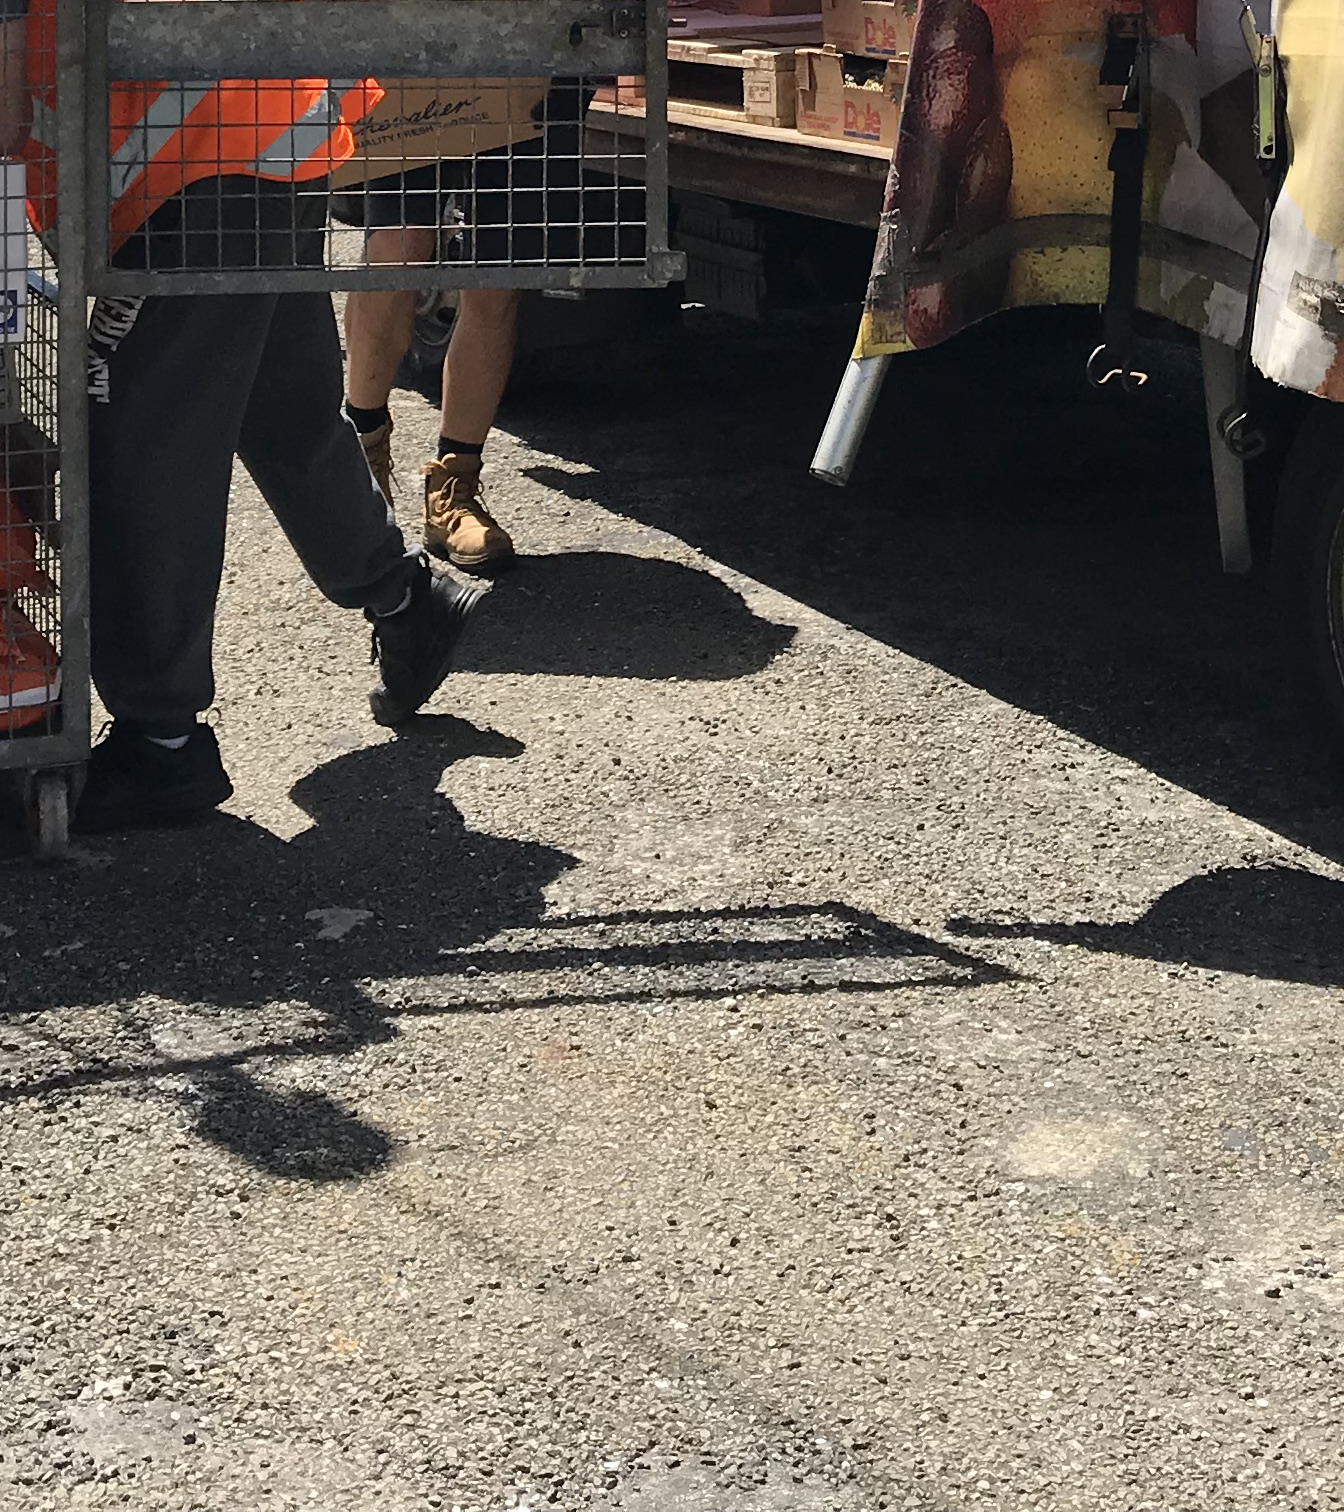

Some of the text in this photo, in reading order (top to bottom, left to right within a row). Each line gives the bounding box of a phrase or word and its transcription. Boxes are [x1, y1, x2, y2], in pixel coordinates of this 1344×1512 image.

[864, 17, 896, 49] Dole
[353, 97, 481, 137] hevalier
[844, 100, 881, 133] Dole
[356, 134, 394, 148] UALITY
